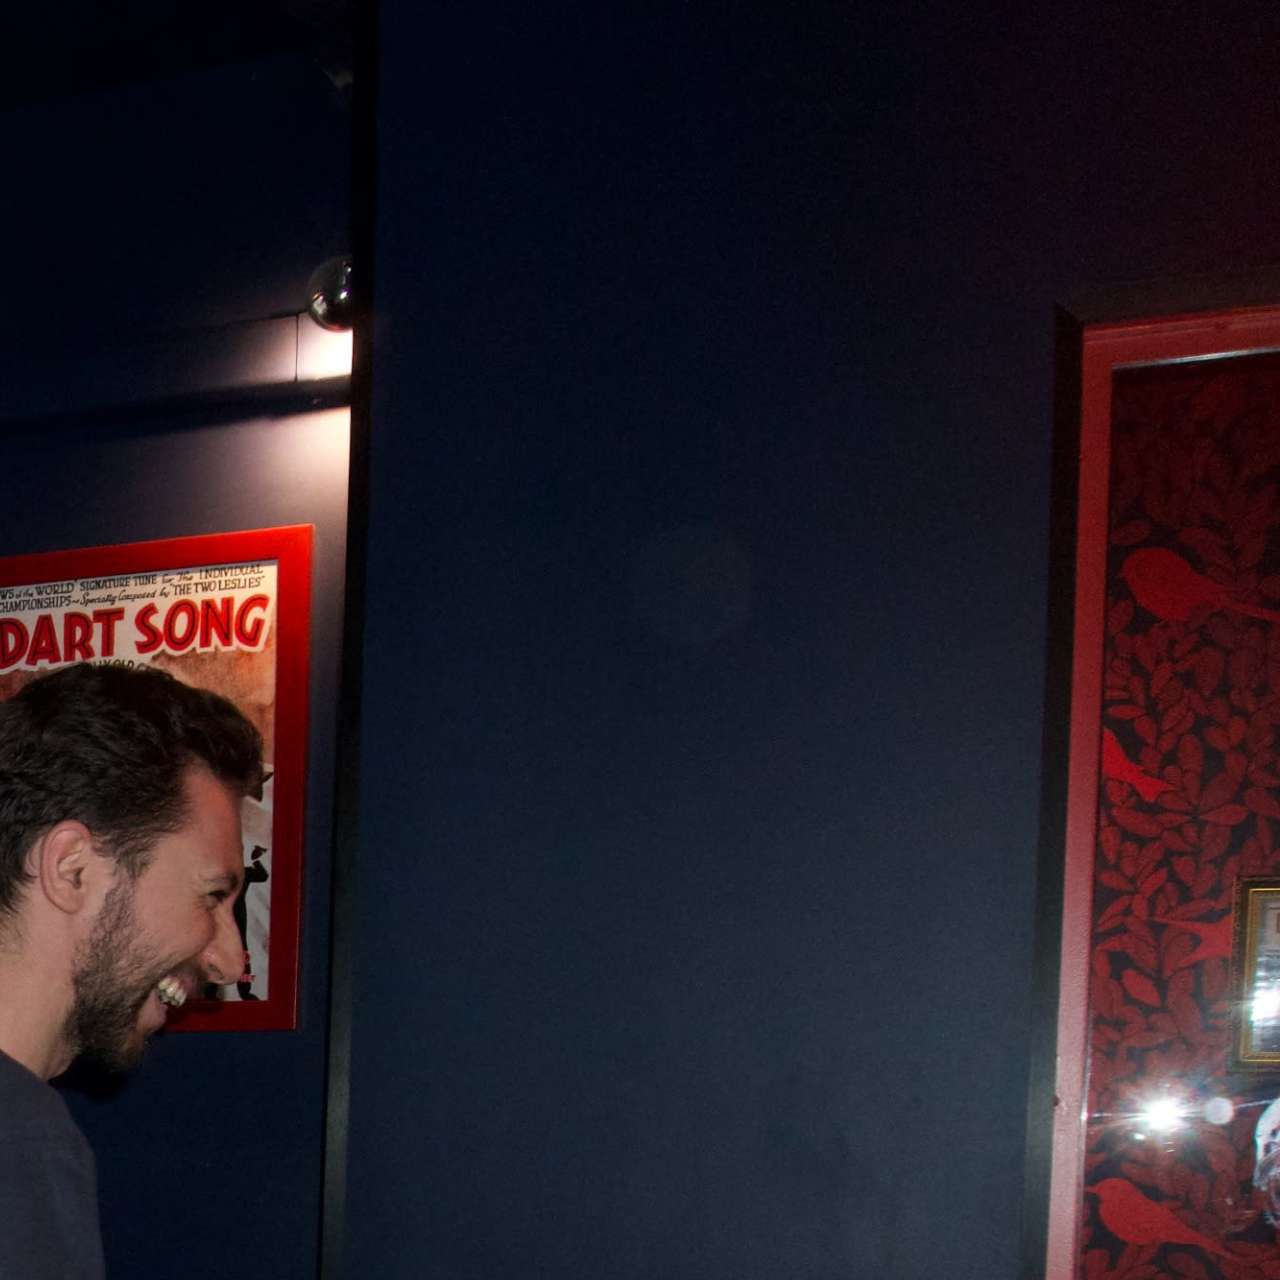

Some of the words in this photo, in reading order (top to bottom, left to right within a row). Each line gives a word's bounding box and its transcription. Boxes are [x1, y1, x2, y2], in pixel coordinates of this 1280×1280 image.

[80, 575, 130, 591] SIGNATURE
[133, 574, 158, 587] TUNE
[200, 563, 264, 580] INDIVIDUAL
[193, 579, 217, 593] TWO
[134, 593, 270, 654] SONG
